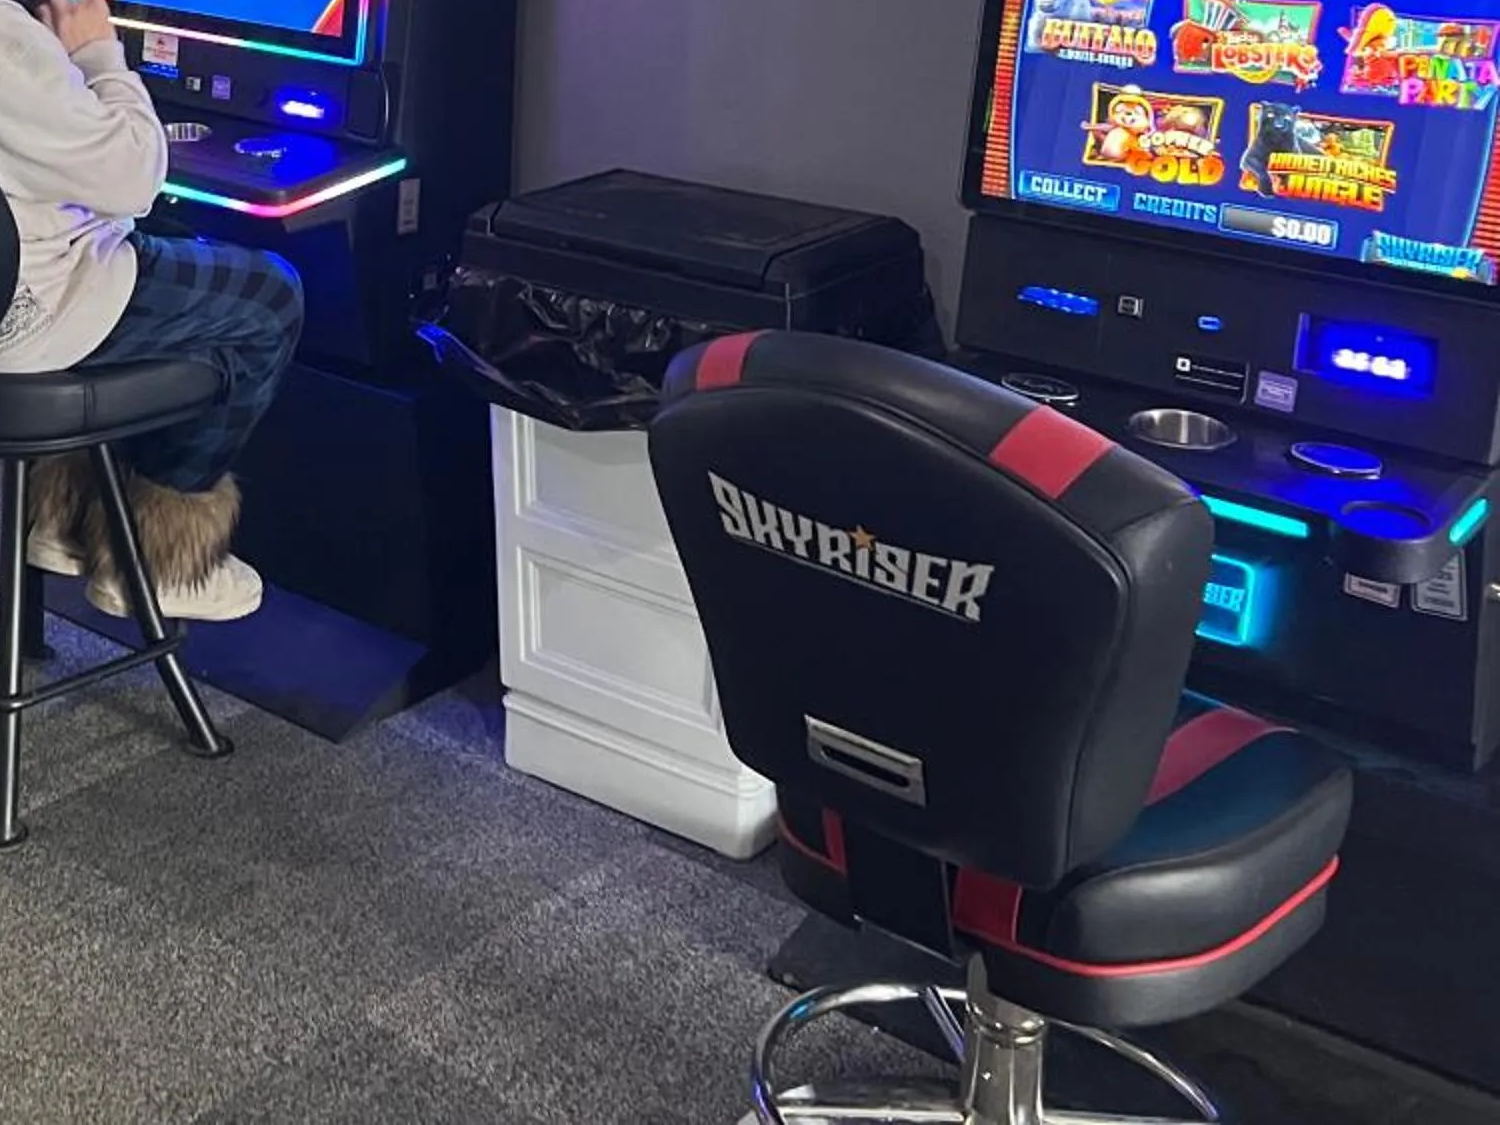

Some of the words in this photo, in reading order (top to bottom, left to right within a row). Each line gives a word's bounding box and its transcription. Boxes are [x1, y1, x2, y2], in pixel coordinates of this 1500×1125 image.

[1041, 18, 1157, 66] BUFFALO
[1211, 41, 1320, 76] LOBSTERS
[1399, 78, 1498, 111] PARTY
[1124, 149, 1225, 186] GOLD
[1030, 176, 1108, 203] COLLECT
[1133, 192, 1218, 223] CREDITS
[1270, 215, 1332, 245] $0.00
[707, 469, 995, 623] SKYRISER
